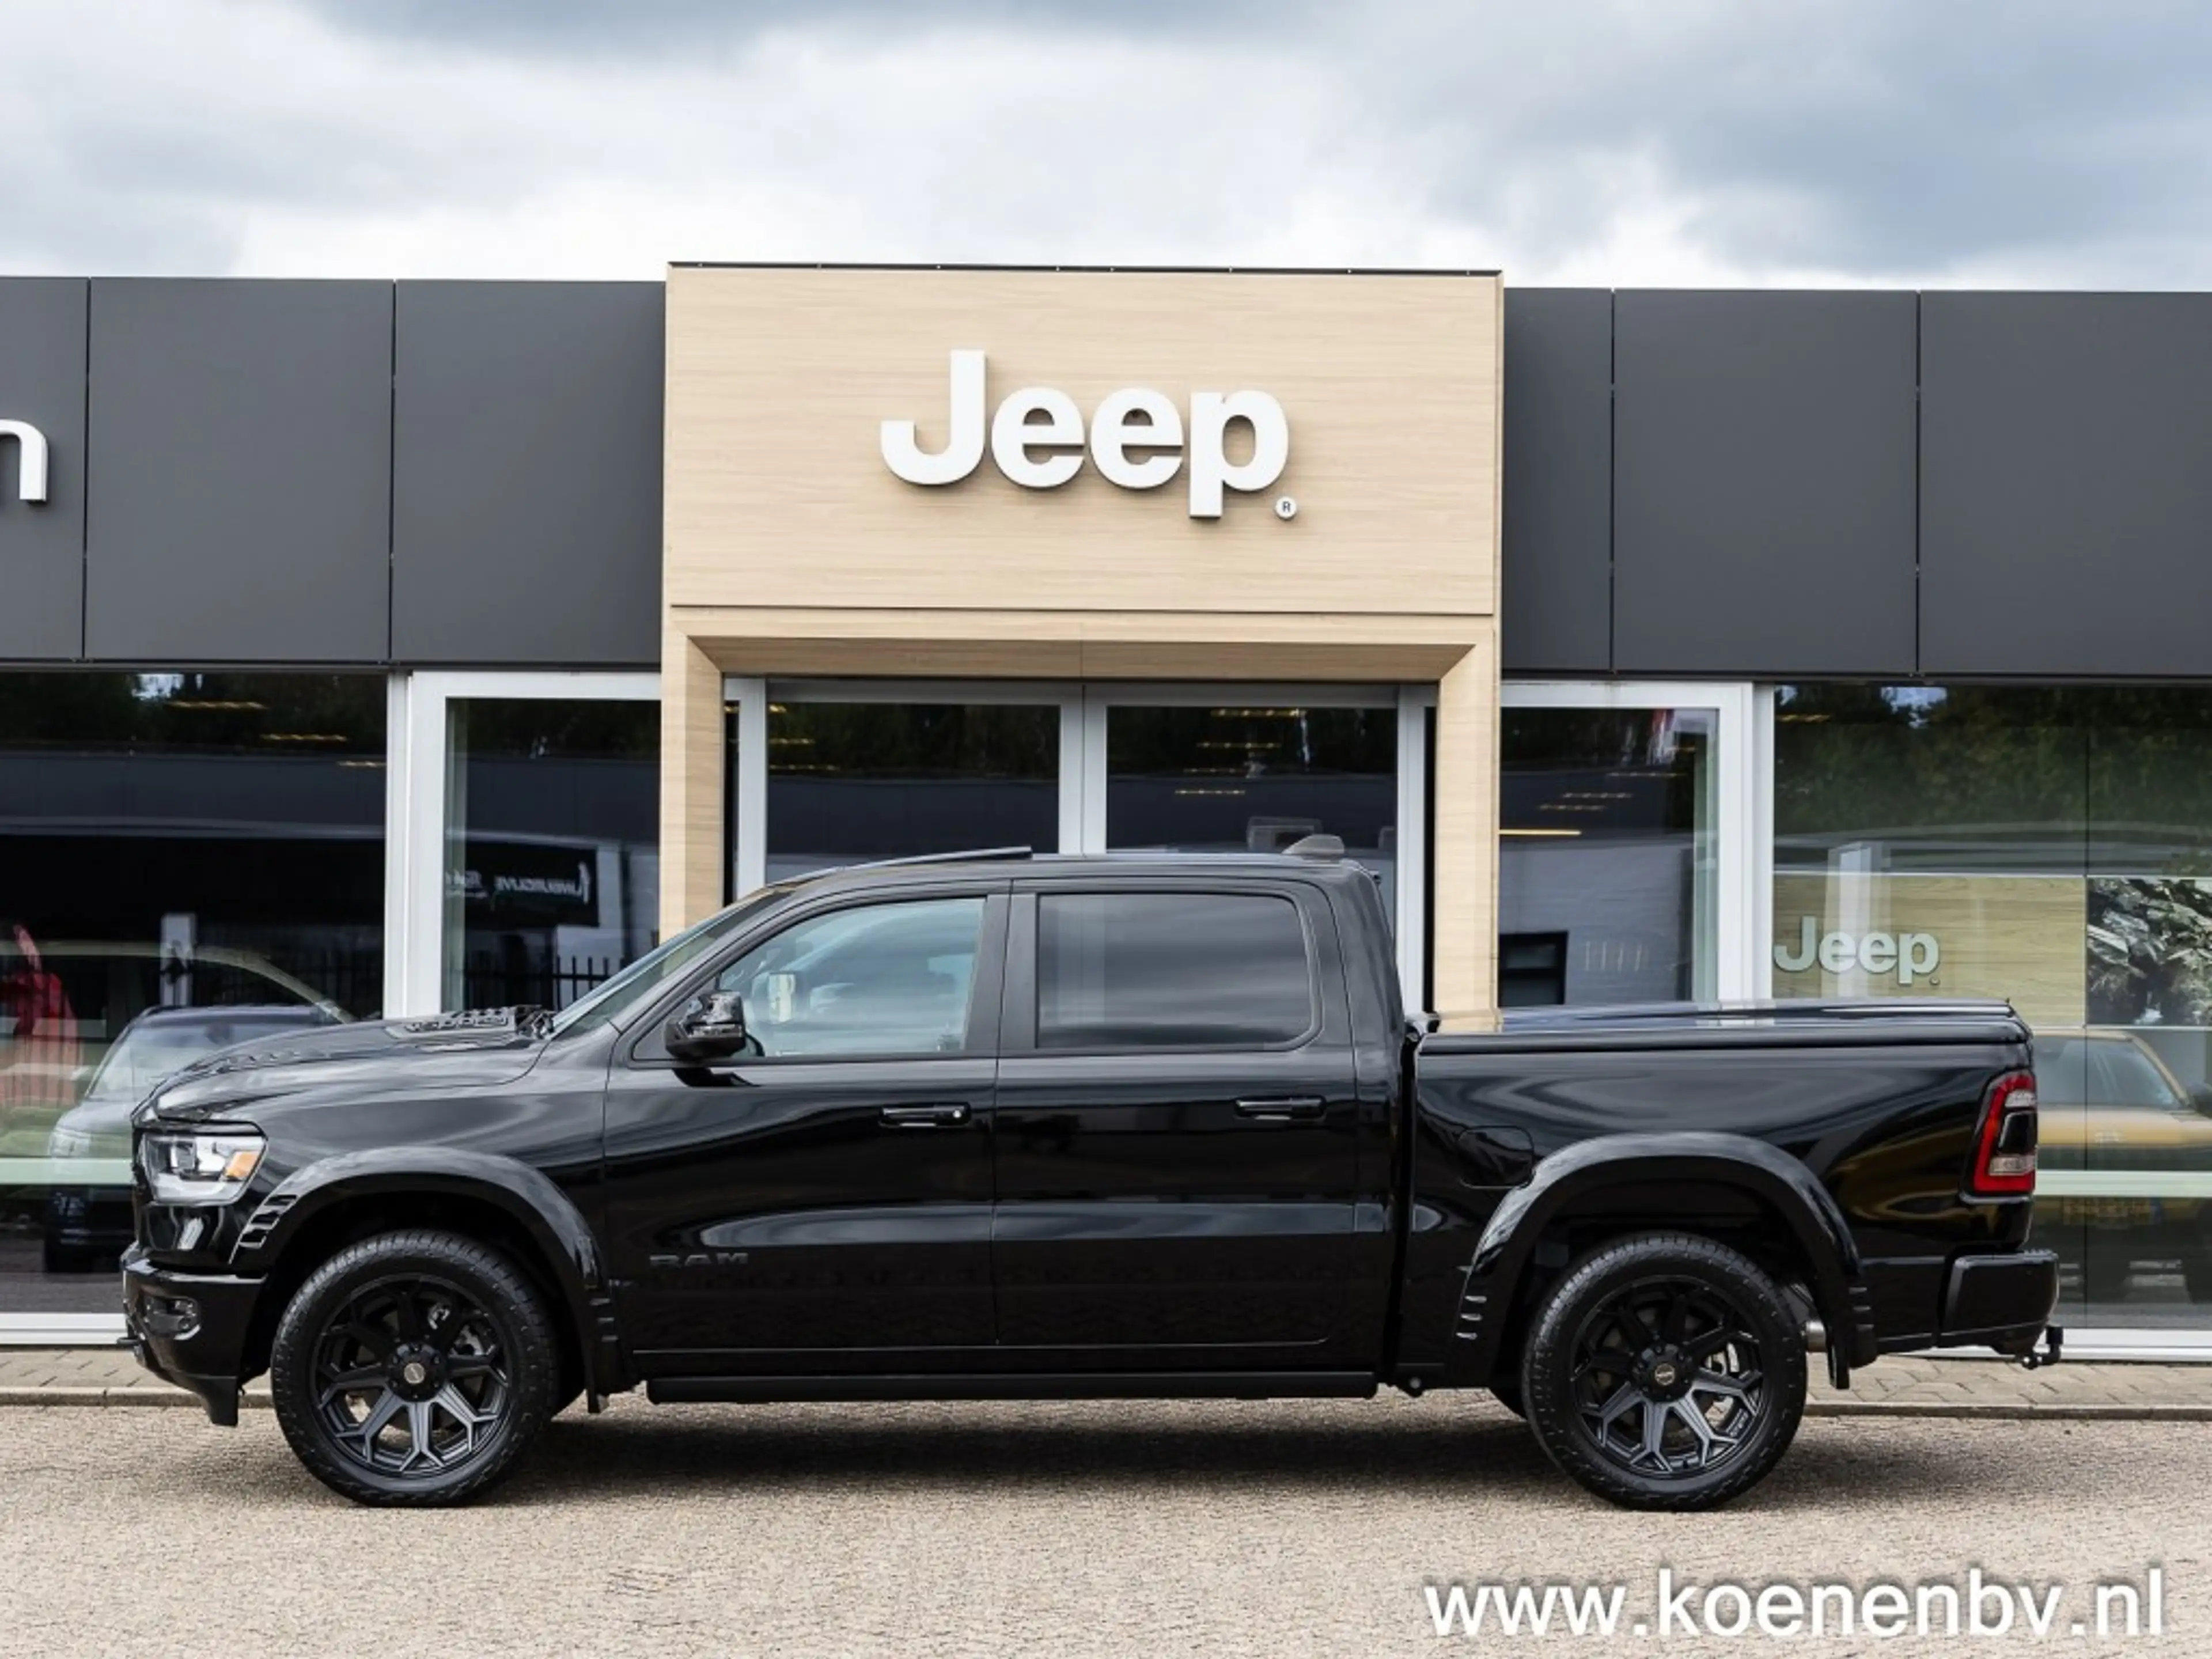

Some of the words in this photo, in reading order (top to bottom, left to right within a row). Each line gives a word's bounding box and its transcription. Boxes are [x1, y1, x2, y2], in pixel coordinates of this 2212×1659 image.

[880, 349, 1289, 519] Jeep
[1774, 916, 1940, 986] Jeep
[649, 1252, 749, 1269] RAM
